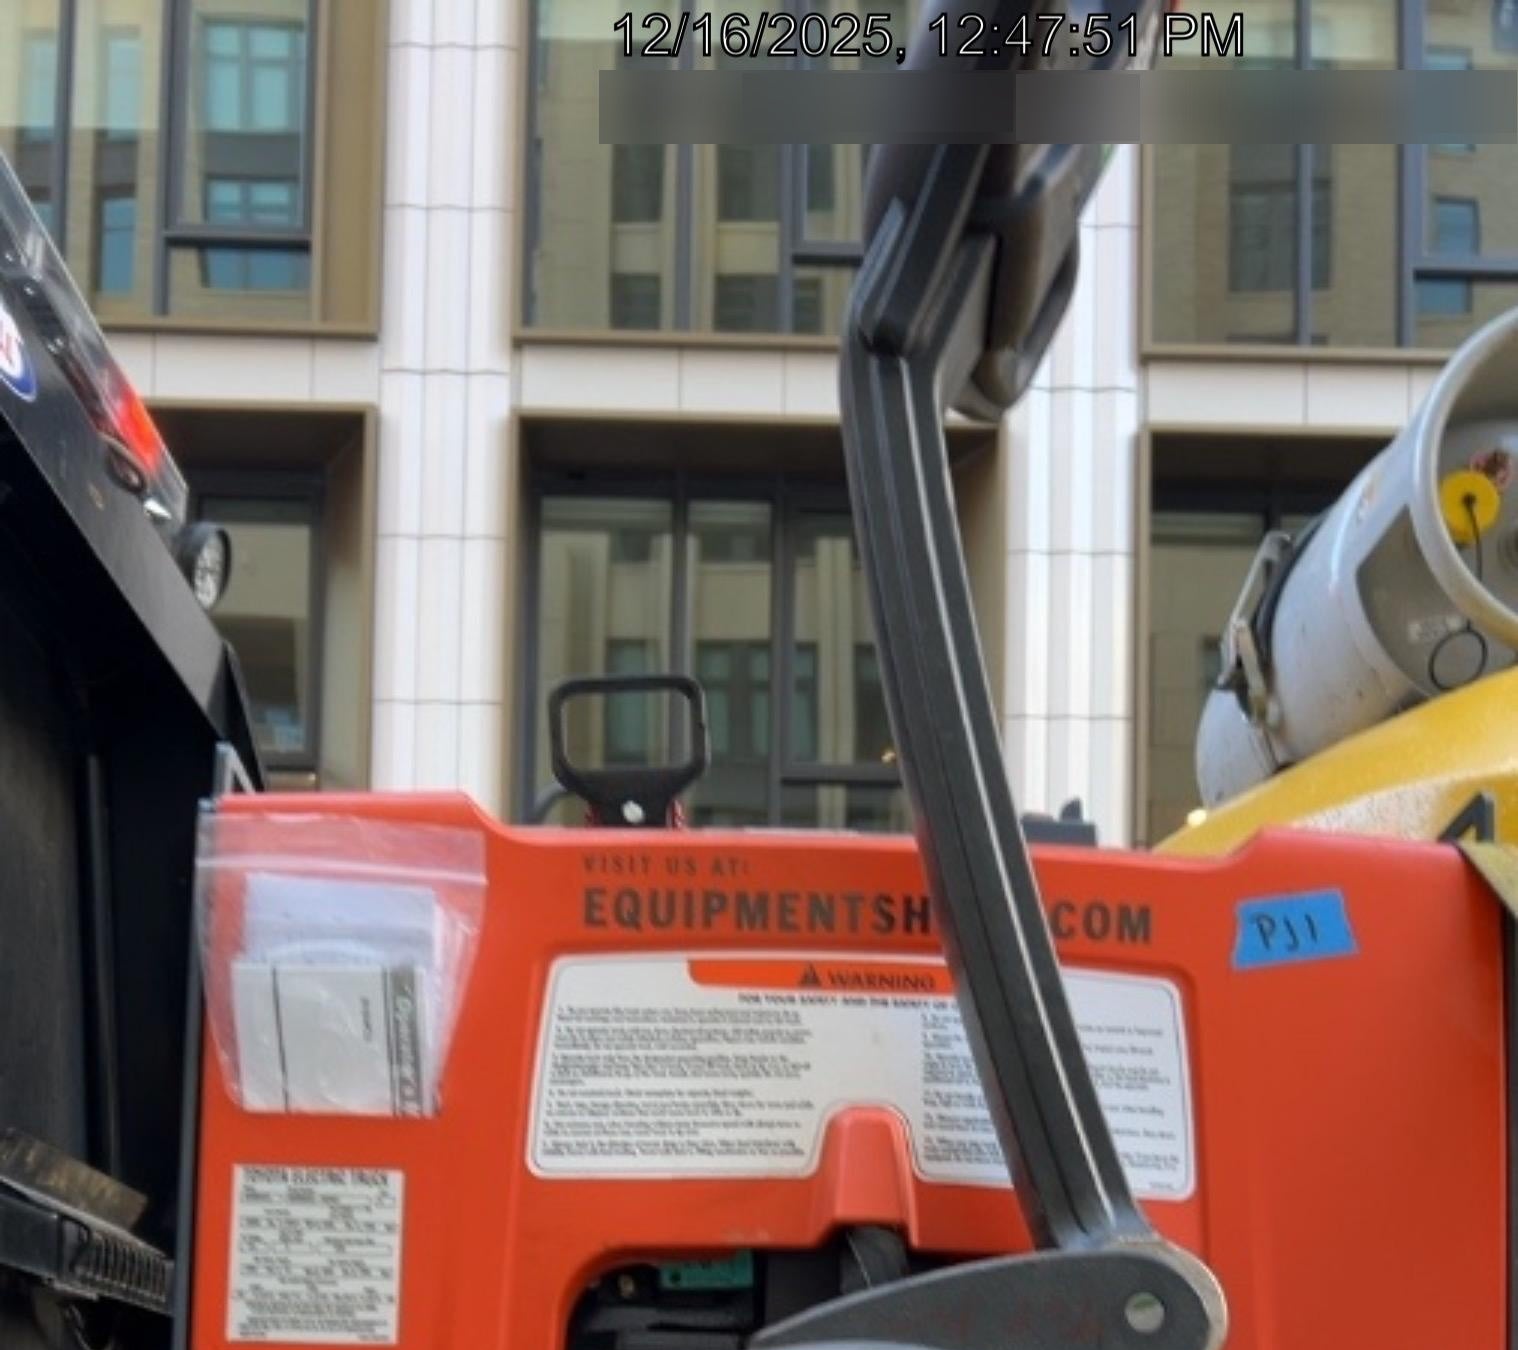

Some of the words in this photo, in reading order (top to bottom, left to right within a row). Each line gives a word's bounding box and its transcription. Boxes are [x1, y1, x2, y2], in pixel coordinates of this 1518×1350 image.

[583, 854, 651, 874] VISIT
[665, 857, 698, 875] US
[711, 858, 750, 877] AT:
[827, 970, 937, 991] WARNING
